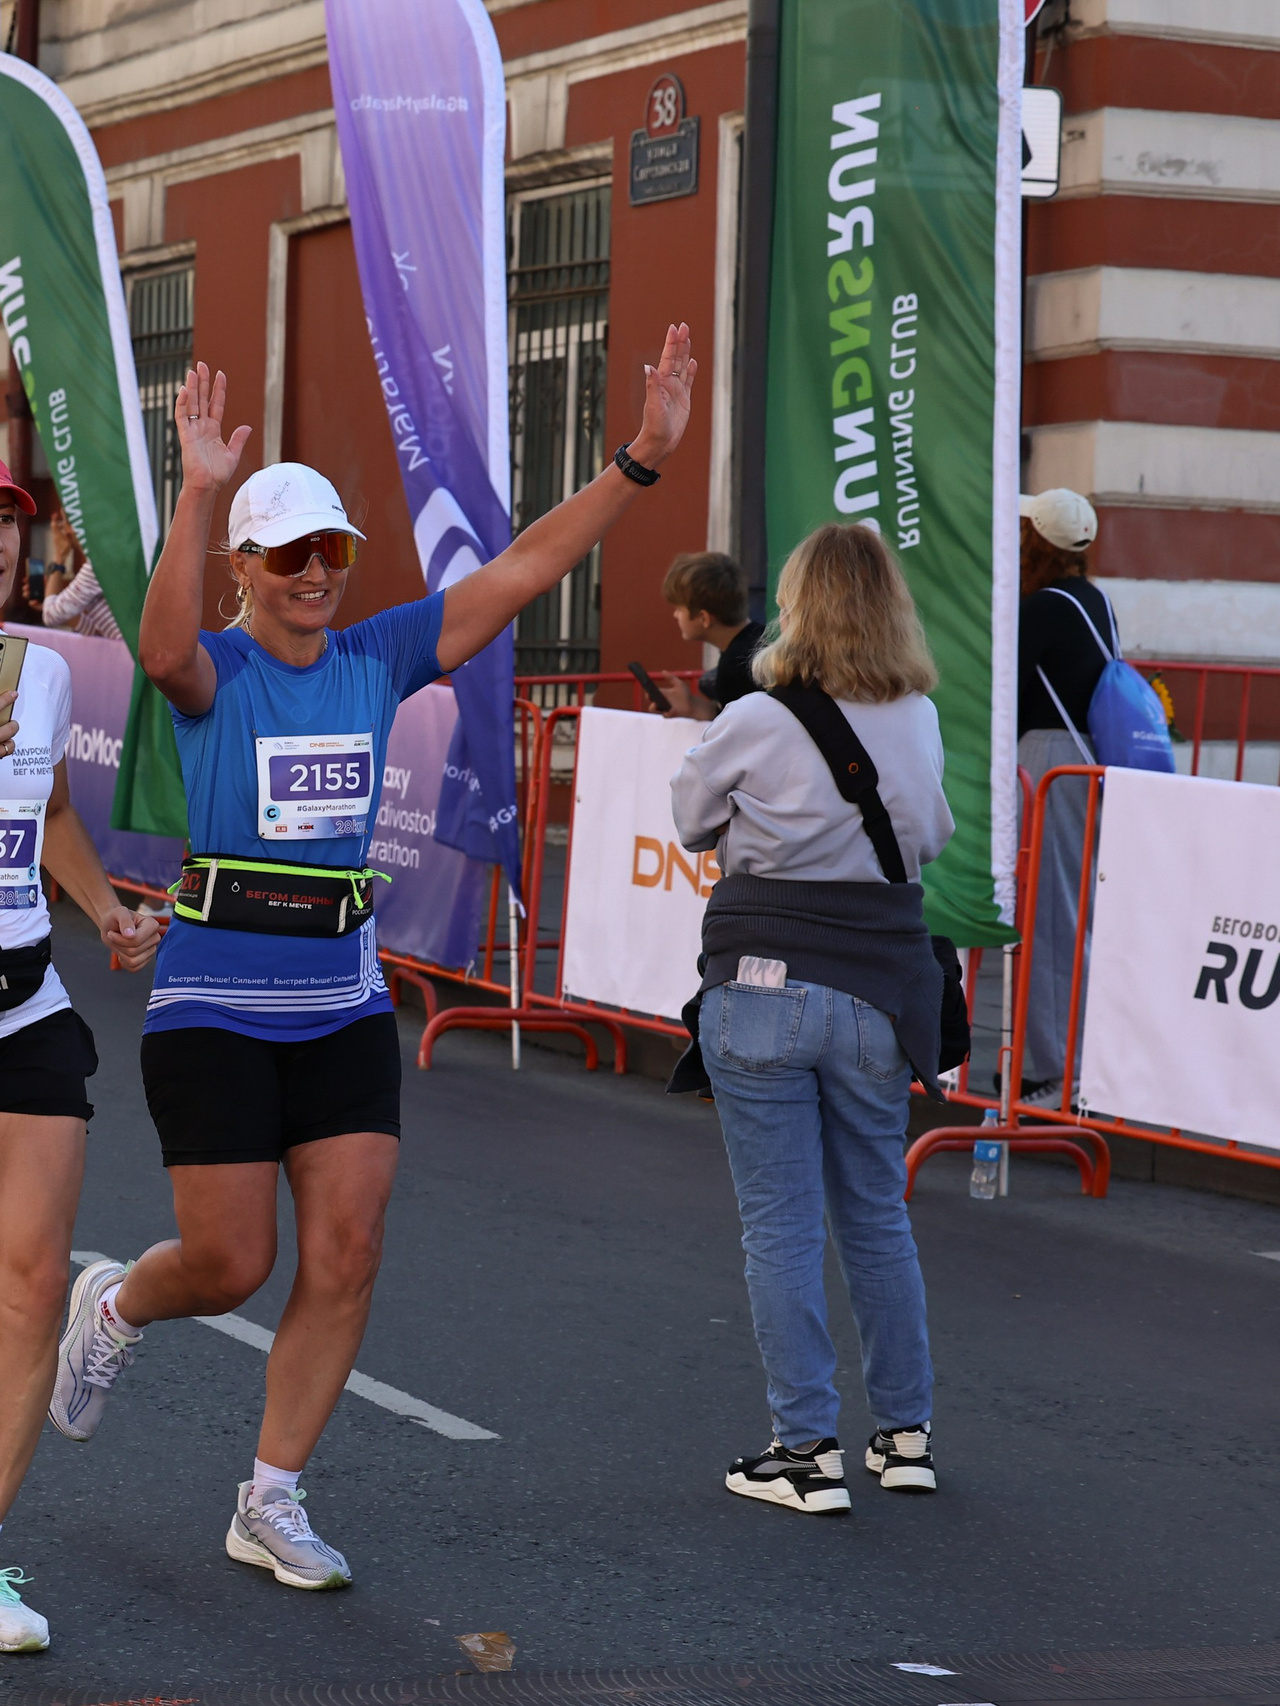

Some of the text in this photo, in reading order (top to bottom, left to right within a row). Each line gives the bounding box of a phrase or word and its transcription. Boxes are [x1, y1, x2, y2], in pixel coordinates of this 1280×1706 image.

[652, 86, 676, 129] 38
[13, 767, 28, 776] БЕГ
[29, 767, 36, 775] К
[289, 762, 361, 792] 2155
[383, 765, 411, 800] axy
[297, 804, 356, 813] #GalaxyMarathon
[366, 837, 420, 868] arathon
[246, 889, 334, 906] БЕГОМ ЕДИНЫ
[288, 902, 312, 910] МЕЧТЕ
[1211, 915, 1280, 943] БЕГОВО
[168, 973, 358, 986] Быстрее! Выше! Сильнее! Быстрее! Выше! Сильнее!
